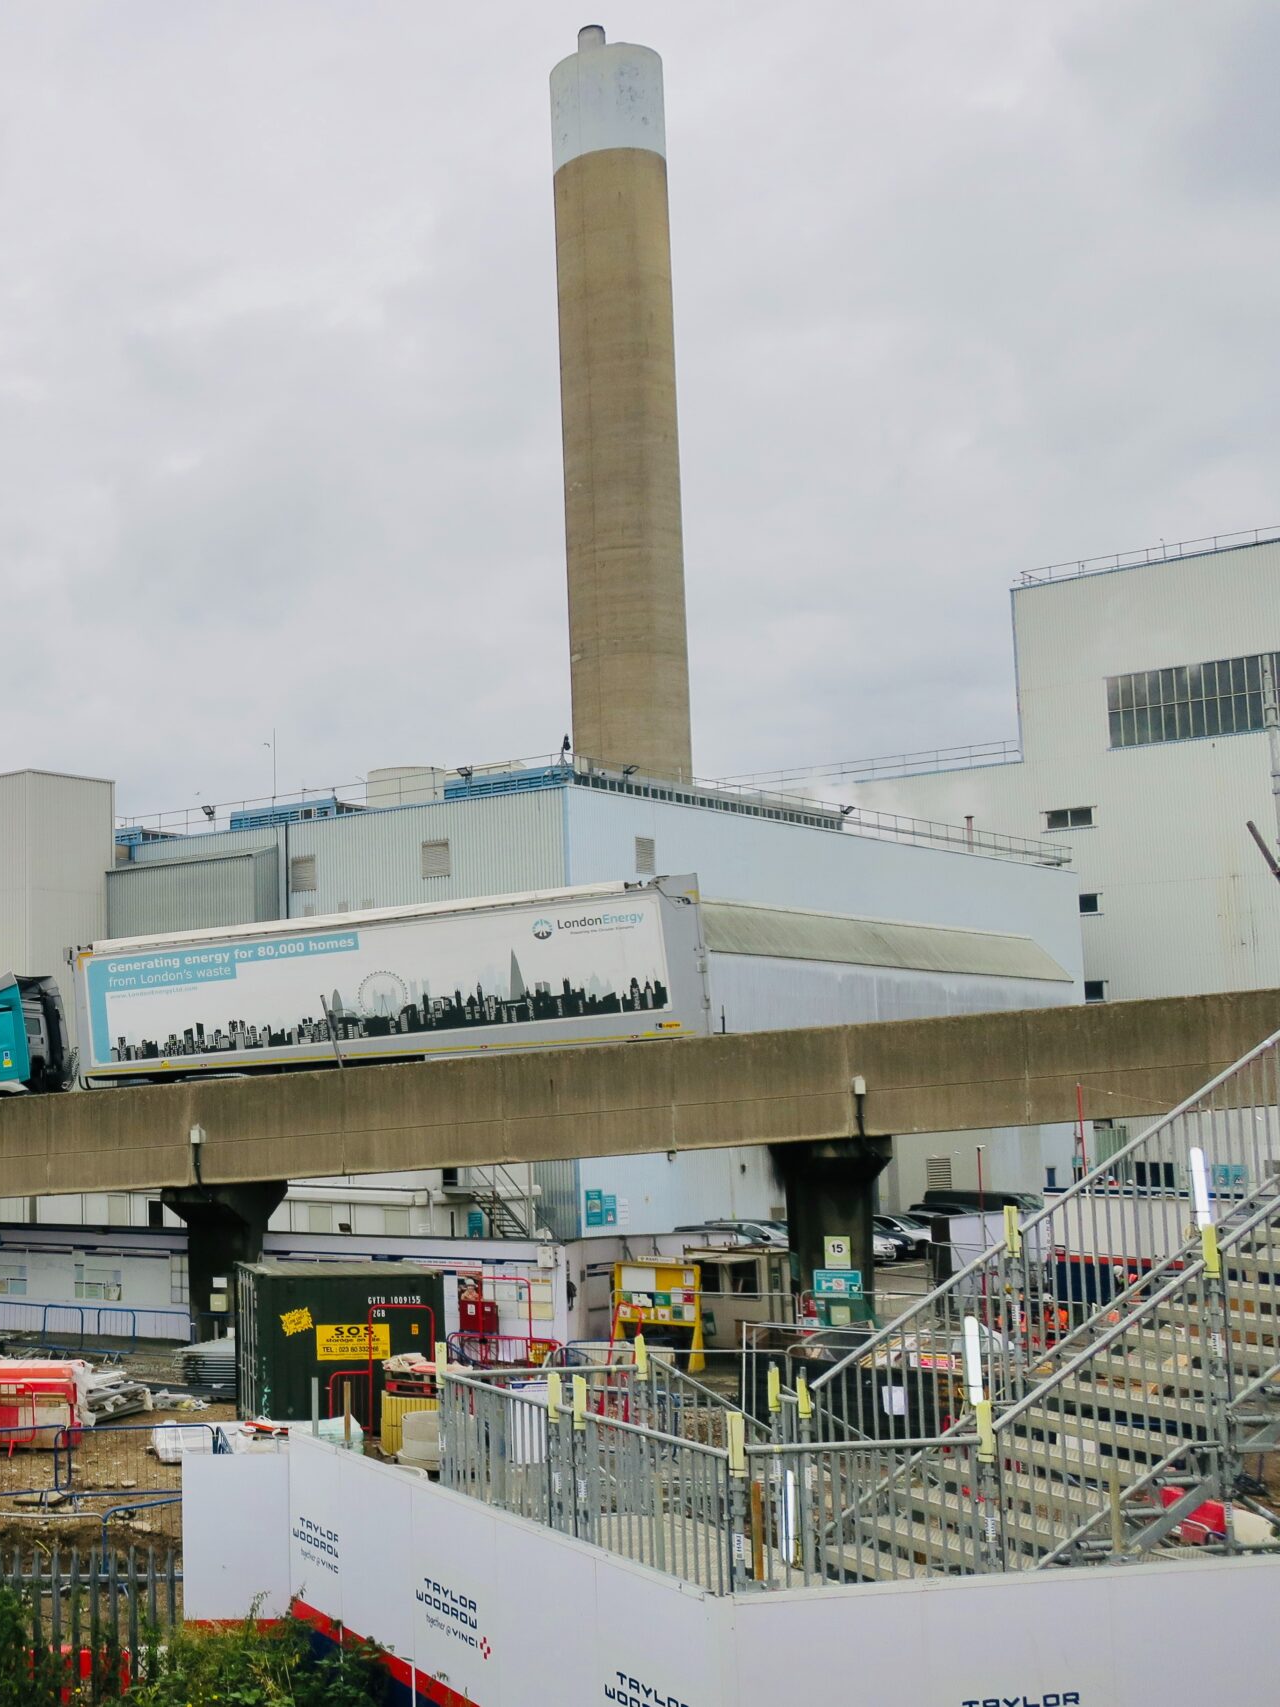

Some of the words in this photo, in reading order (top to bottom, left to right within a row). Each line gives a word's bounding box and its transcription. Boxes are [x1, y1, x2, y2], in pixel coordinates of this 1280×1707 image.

[557, 913, 644, 930] LondonEnergy
[108, 957, 180, 973] Generating
[184, 952, 230, 966] energy
[234, 949, 253, 959] for
[258, 943, 305, 957] 80,000
[309, 938, 354, 951] homes
[109, 977, 136, 988] from
[196, 966, 232, 978] waste
[831, 1243, 843, 1254] 15
[334, 1326, 374, 1336] SOS
[320, 1558, 339, 1575] VINC
[424, 1577, 477, 1613] TAYLOR
[416, 1589, 477, 1630] WOODROW
[452, 1627, 479, 1649] VINCI
[616, 1671, 689, 1707] TAYLO
